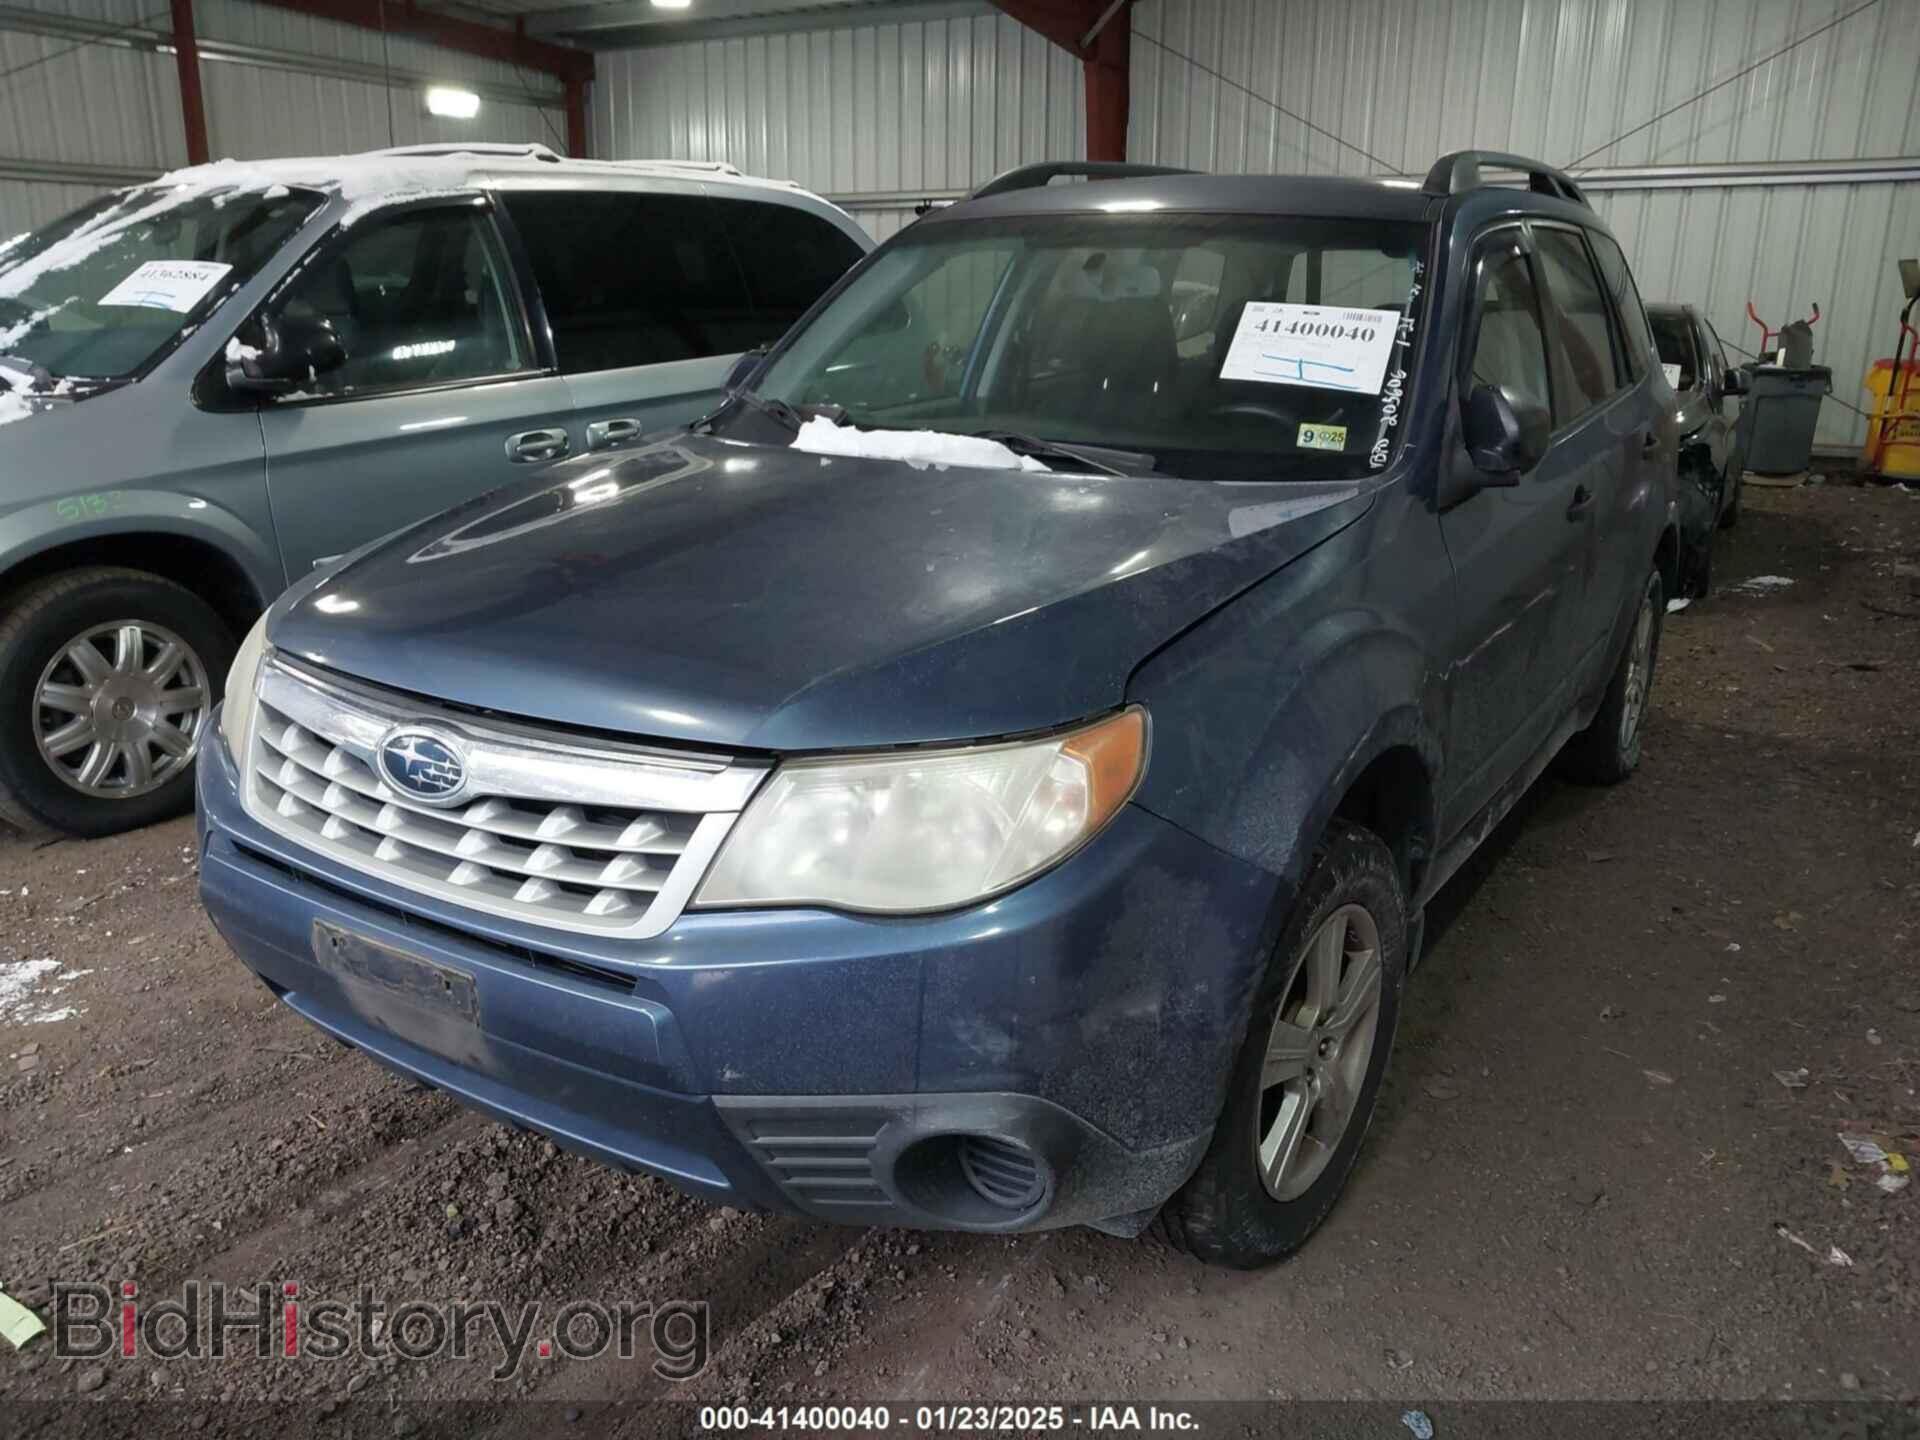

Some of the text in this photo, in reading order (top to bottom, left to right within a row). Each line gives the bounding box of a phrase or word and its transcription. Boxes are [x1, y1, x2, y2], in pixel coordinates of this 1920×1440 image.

[1254, 318, 1376, 343] 41400040
[1303, 430, 1345, 443] 9 25
